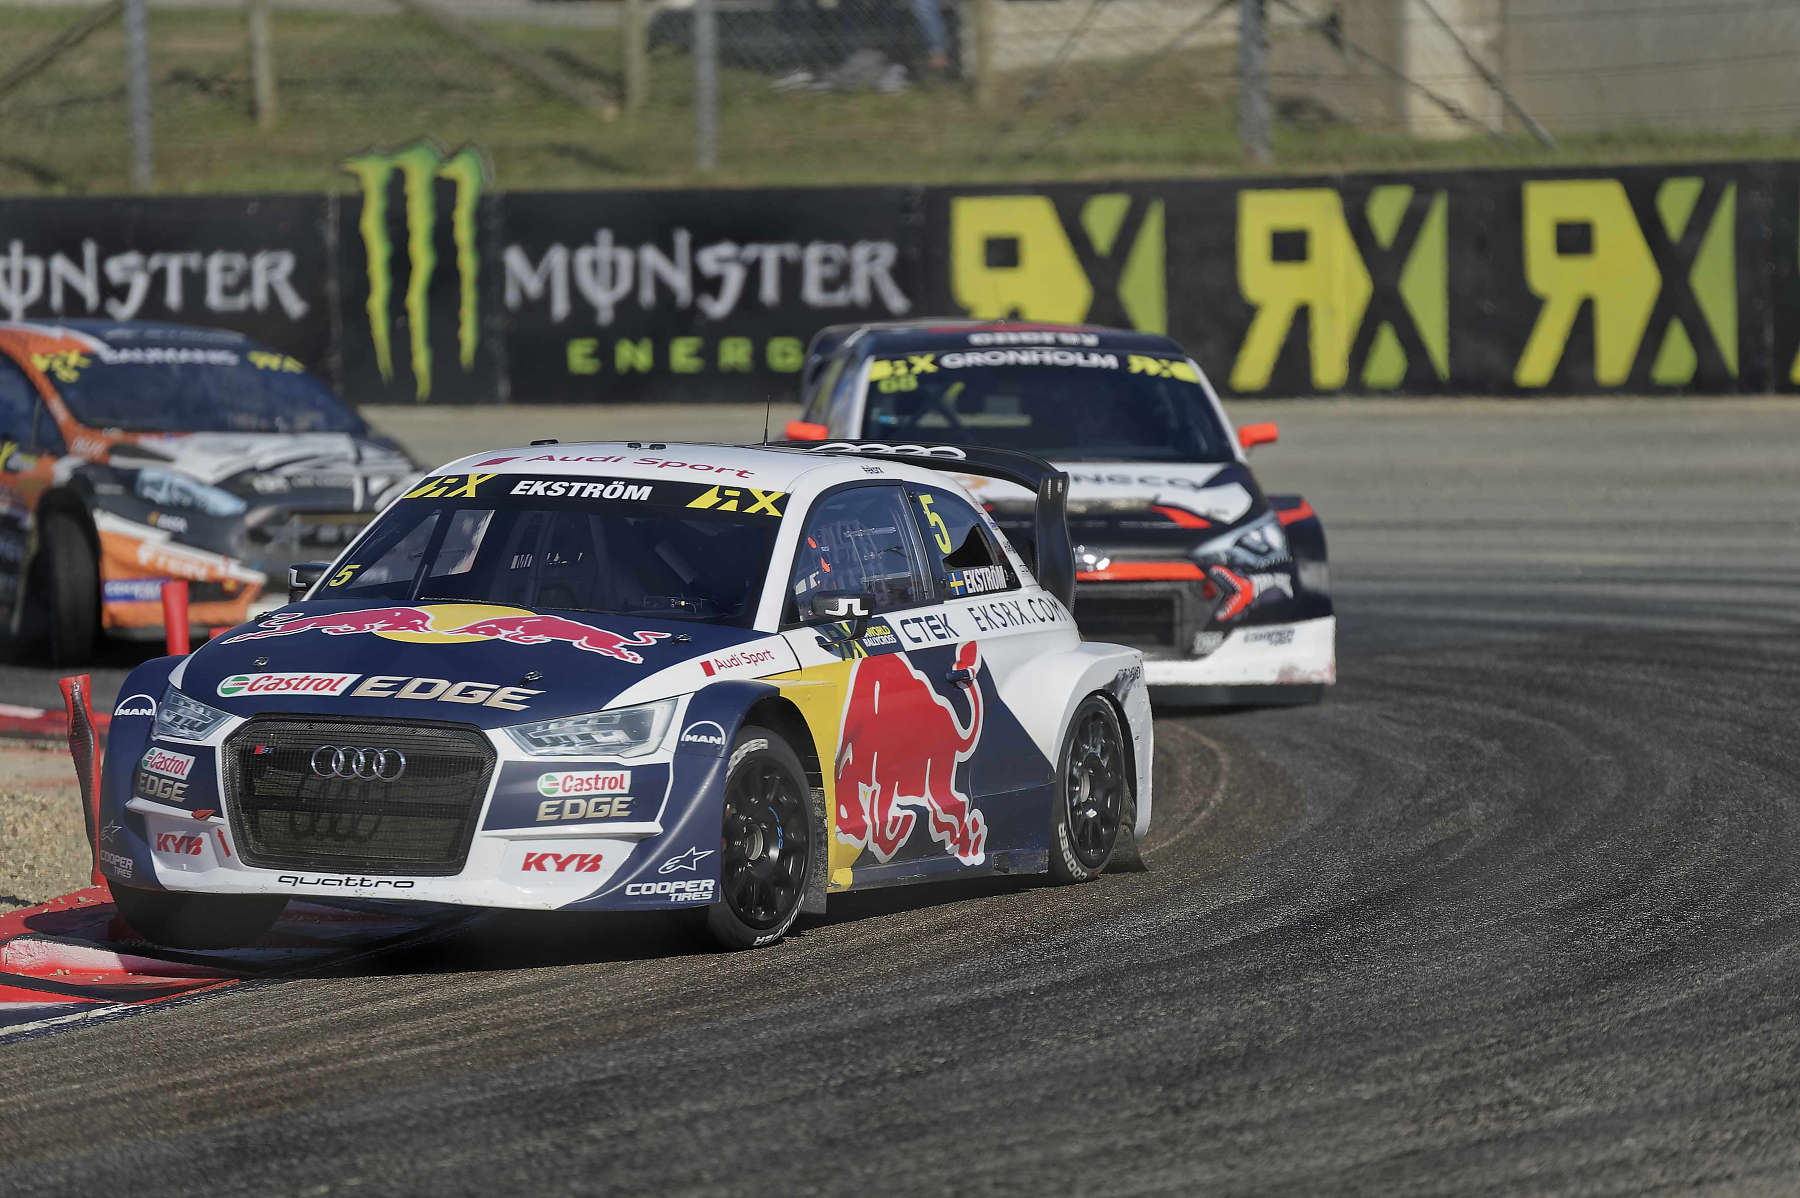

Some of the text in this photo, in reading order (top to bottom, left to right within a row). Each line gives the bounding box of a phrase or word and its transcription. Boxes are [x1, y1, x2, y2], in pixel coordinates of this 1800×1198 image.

[0, 237, 309, 322] ONSTER
[502, 227, 911, 325] MONSTER
[566, 336, 804, 375] ENERG
[526, 453, 755, 478] Audi Sport
[509, 480, 653, 501] EKSTRÖM
[918, 493, 952, 555] 5
[328, 564, 361, 587] 5
[962, 565, 1007, 594] EKSTRÖM
[967, 598, 1070, 632] EKSRX.COM
[900, 613, 960, 644] CTEK
[714, 649, 775, 671] Audi Sport
[248, 674, 546, 711] Castrol EDGE
[116, 707, 153, 717] MAN
[684, 734, 722, 745] MAN
[150, 751, 190, 776] Castrol
[138, 772, 190, 803] EDGE
[561, 773, 625, 793] Castrol
[536, 797, 634, 822] EDGE
[156, 831, 203, 857] KYB
[101, 850, 134, 871] COOPER
[521, 852, 604, 873] KYB
[278, 874, 415, 889] quattro
[625, 878, 716, 896] COOPER
[668, 890, 714, 902] TIRES
